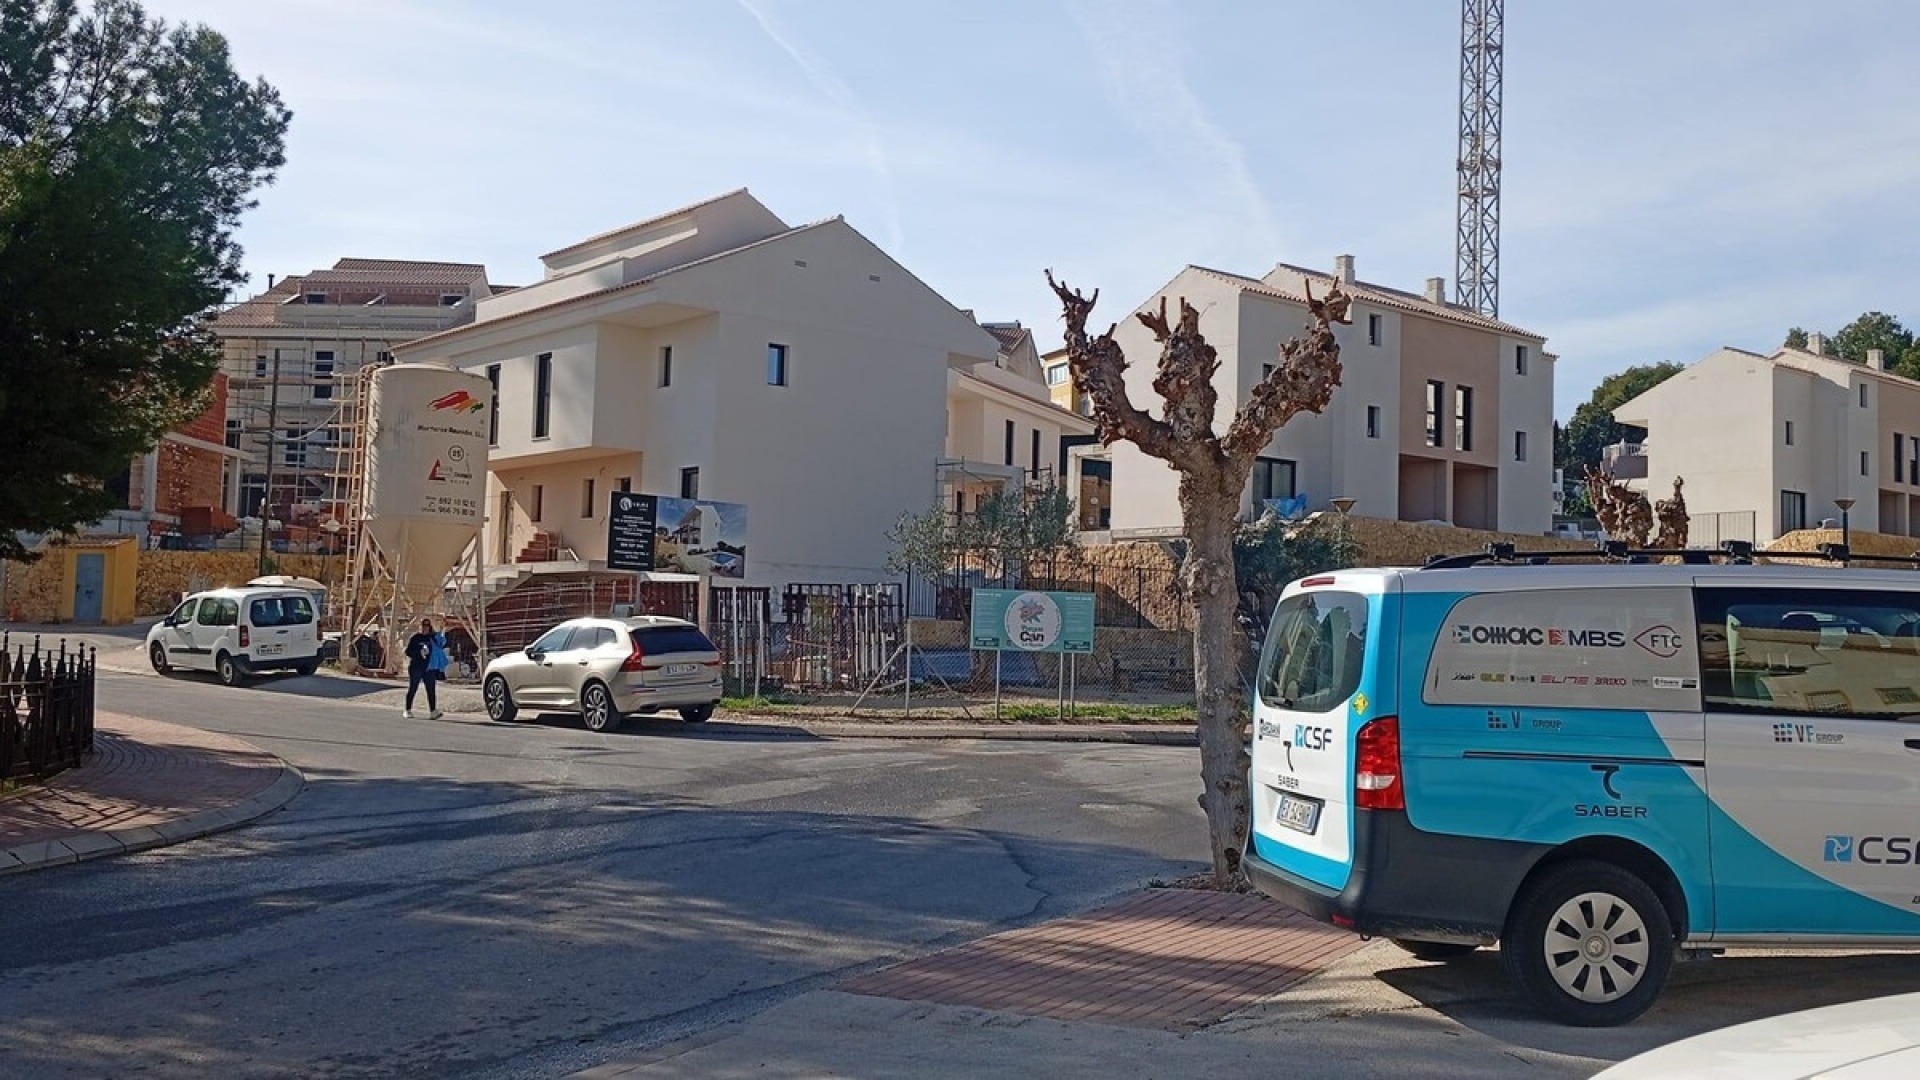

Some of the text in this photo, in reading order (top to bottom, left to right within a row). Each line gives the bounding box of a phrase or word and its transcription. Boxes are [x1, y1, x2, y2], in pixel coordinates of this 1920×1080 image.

[1020, 631, 1044, 642] Can
[1569, 630, 1626, 647] MBS
[1651, 634, 1682, 649] FTC
[1532, 719, 1562, 729] GROUP
[1304, 725, 1332, 751] CSF
[1816, 733, 1844, 743] GROUP
[1278, 774, 1299, 789] SABER
[1574, 804, 1647, 818] SABER
